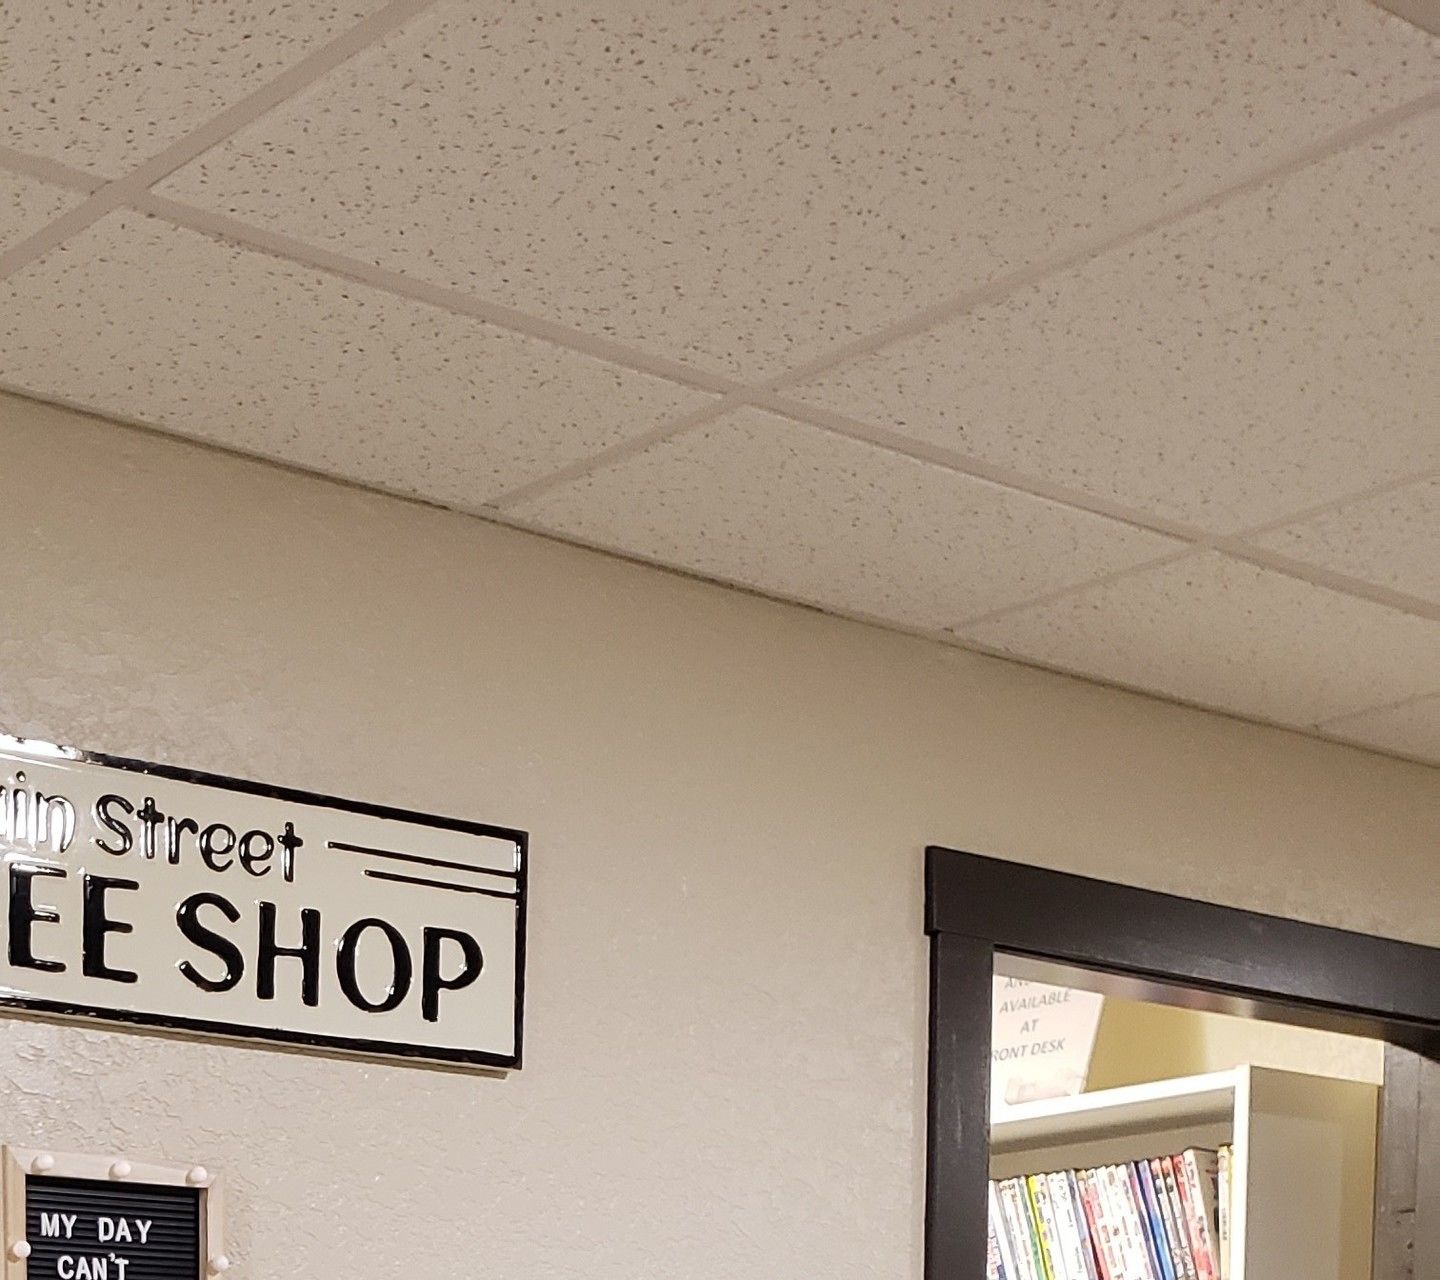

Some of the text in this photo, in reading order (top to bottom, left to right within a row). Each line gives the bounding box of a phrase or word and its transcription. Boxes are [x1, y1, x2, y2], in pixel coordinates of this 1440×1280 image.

[91, 793, 299, 883] Street
[177, 891, 484, 1023] SHOP
[999, 990, 1072, 1014] AVAILABLE
[1020, 1018, 1040, 1034] AT
[991, 1037, 1066, 1061] RONT DESK
[40, 1213, 152, 1244] MY DAY
